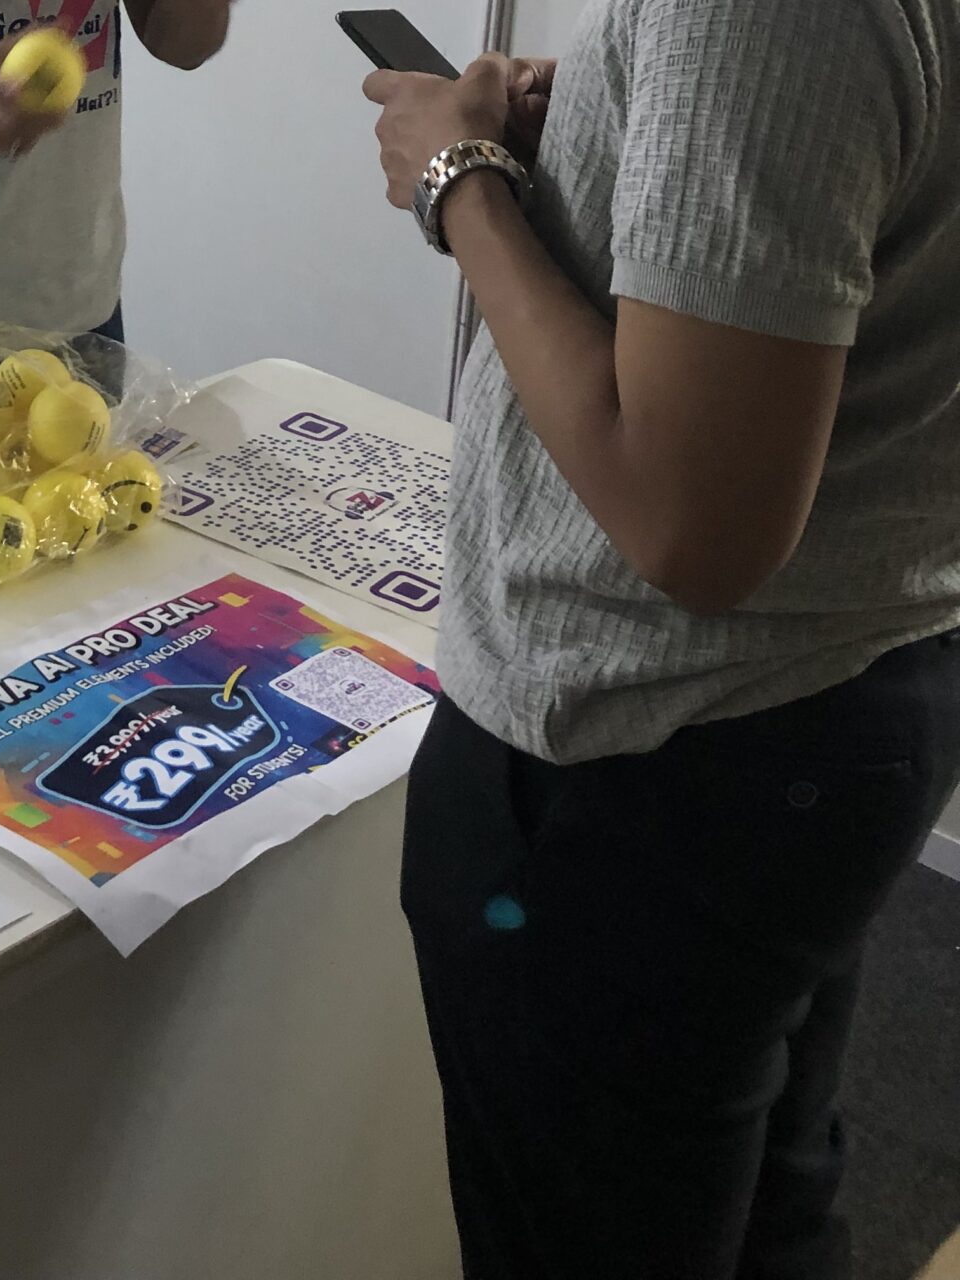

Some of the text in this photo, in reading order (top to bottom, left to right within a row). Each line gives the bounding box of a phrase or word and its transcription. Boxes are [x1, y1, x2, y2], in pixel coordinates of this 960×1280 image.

[8, 688, 80, 729] PREMIUM
[75, 659, 150, 690] ELEMENTS
[146, 624, 218, 664] INCLUDED!
[31, 653, 76, 682] AI
[65, 627, 138, 666] PRO
[128, 595, 215, 635] DEAL
[224, 743, 308, 801] FOR STUDENTS!
